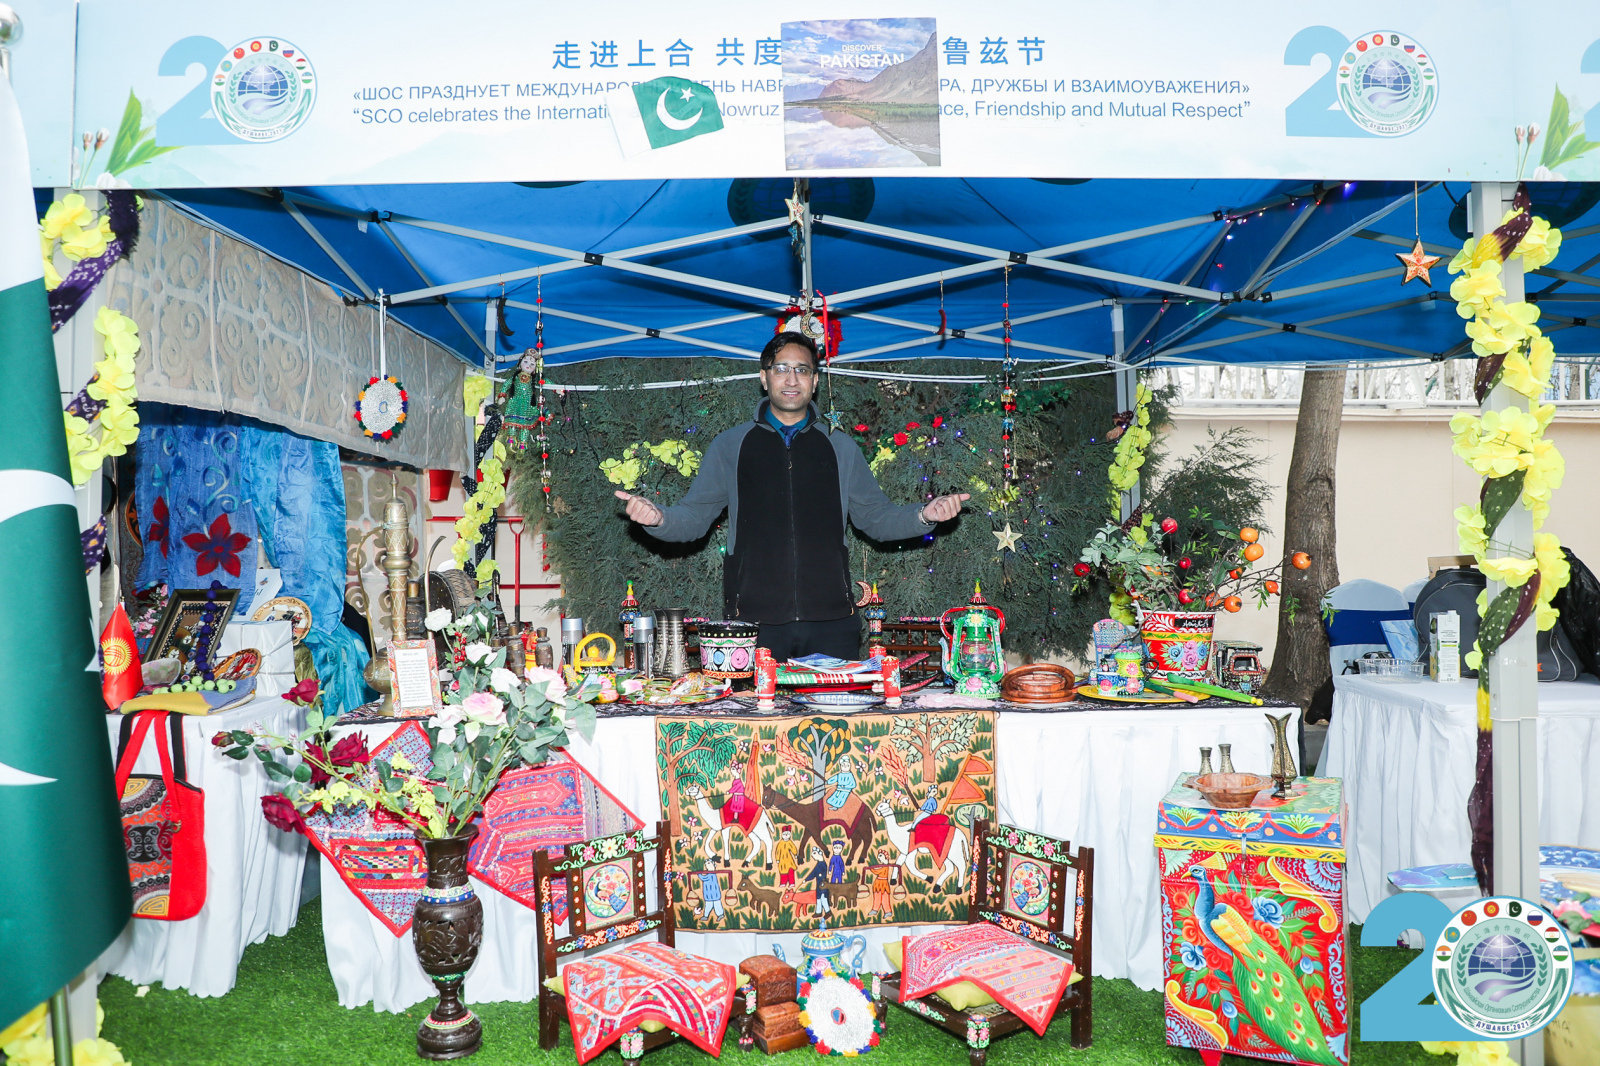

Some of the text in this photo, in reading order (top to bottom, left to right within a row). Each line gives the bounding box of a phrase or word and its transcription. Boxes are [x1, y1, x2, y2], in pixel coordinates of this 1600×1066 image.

[552, 38, 693, 70] 走进上合
[841, 44, 884, 52] DISCOVER
[820, 53, 906, 69] PAKISTAN
[353, 87, 403, 101] «ШОС
[408, 84, 512, 101] ПРАЗДНУЕТ
[694, 79, 736, 93] ЕНЬ
[742, 79, 783, 93] НАВ
[939, 78, 967, 94] РА,
[971, 78, 1048, 95] ДРУЖБЫ
[1054, 79, 1065, 93] И
[1071, 79, 1251, 95] ВЗАИМОУВАЖЕНИЯ»
[353, 107, 403, 124] “SCO
[408, 106, 500, 123] celebrates
[504, 105, 531, 121] the
[537, 104, 608, 120] Internati
[975, 100, 1066, 120] Friendship
[1072, 101, 1104, 117] and
[1109, 101, 1167, 118] Mutual
[1172, 101, 1251, 121] Respect”
